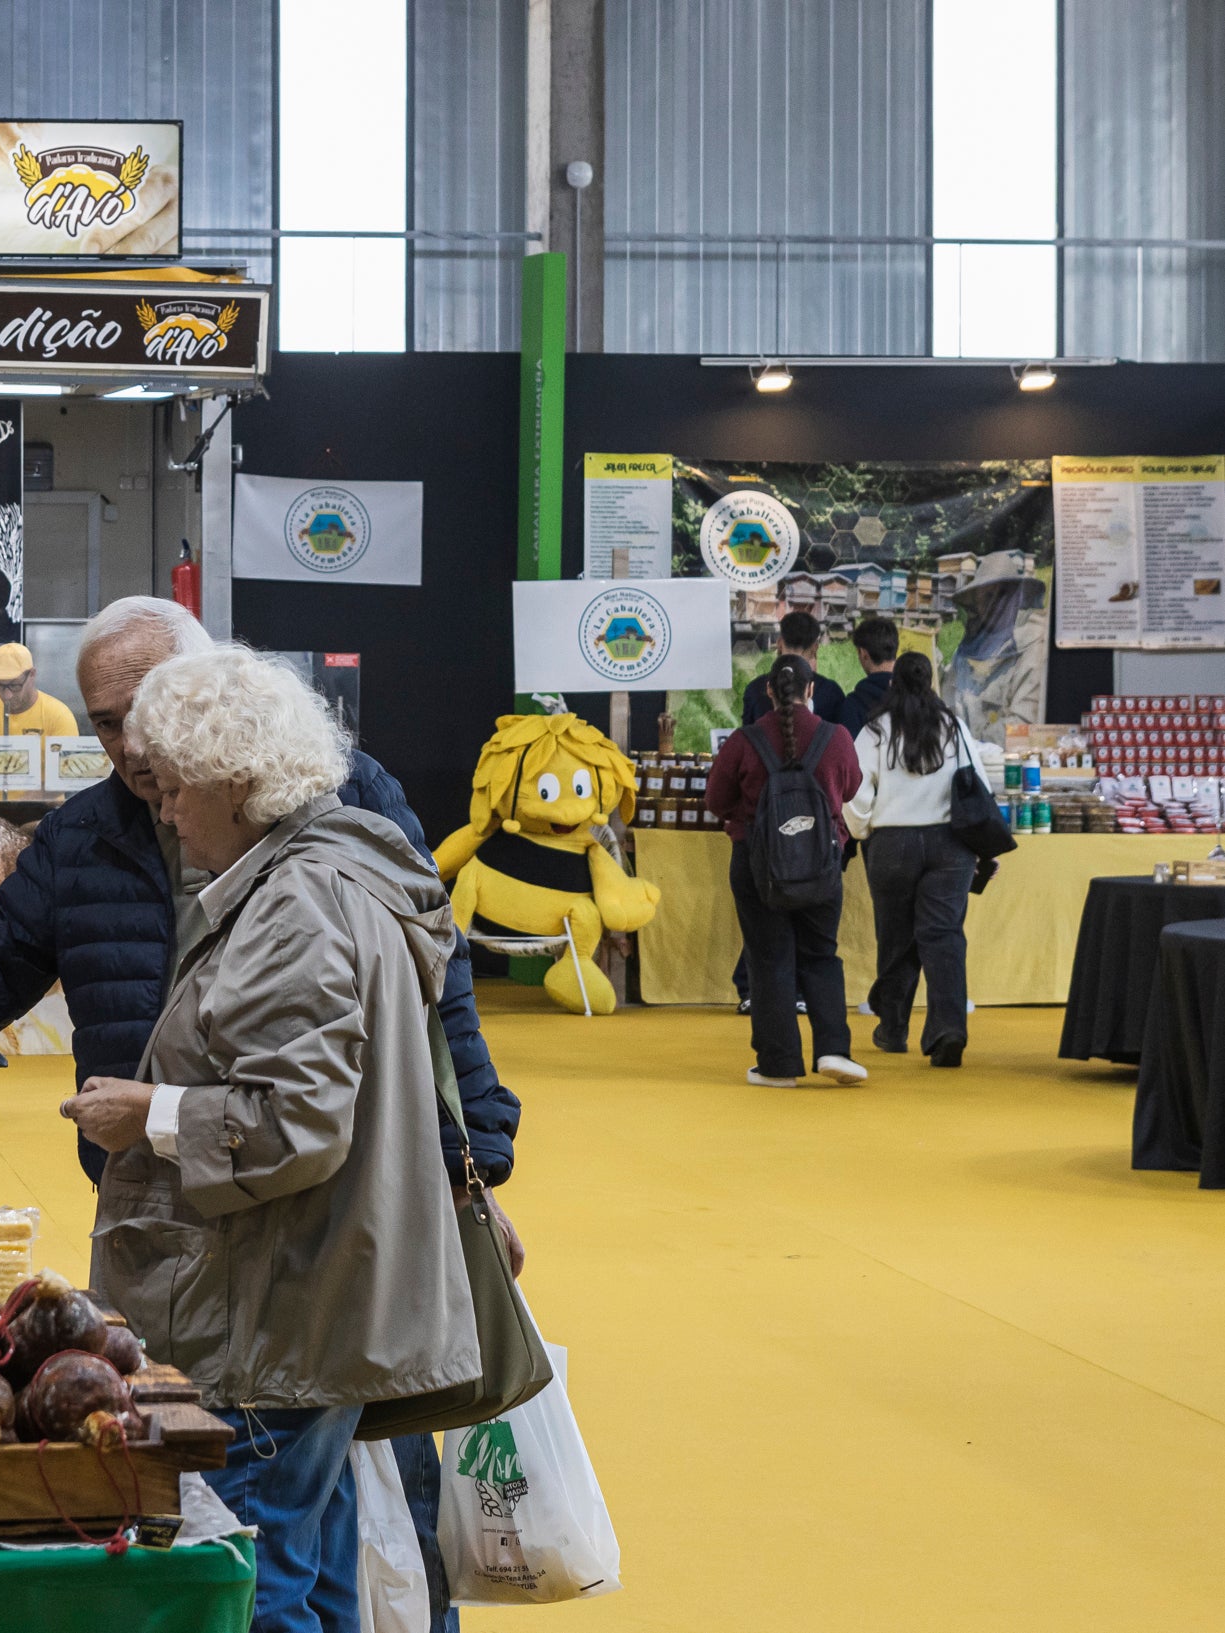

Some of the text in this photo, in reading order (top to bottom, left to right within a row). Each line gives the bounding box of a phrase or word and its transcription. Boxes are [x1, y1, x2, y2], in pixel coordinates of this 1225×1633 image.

[76, 151, 118, 167] Tradicional
[28, 182, 125, 237] d'Avó
[145, 327, 219, 366] d'Avó
[629, 463, 656, 474] FRESCA
[299, 501, 357, 526] La Caballera
[716, 507, 783, 537] La Caballera
[620, 592, 645, 601] Natural
[594, 604, 655, 630] La Caballera
